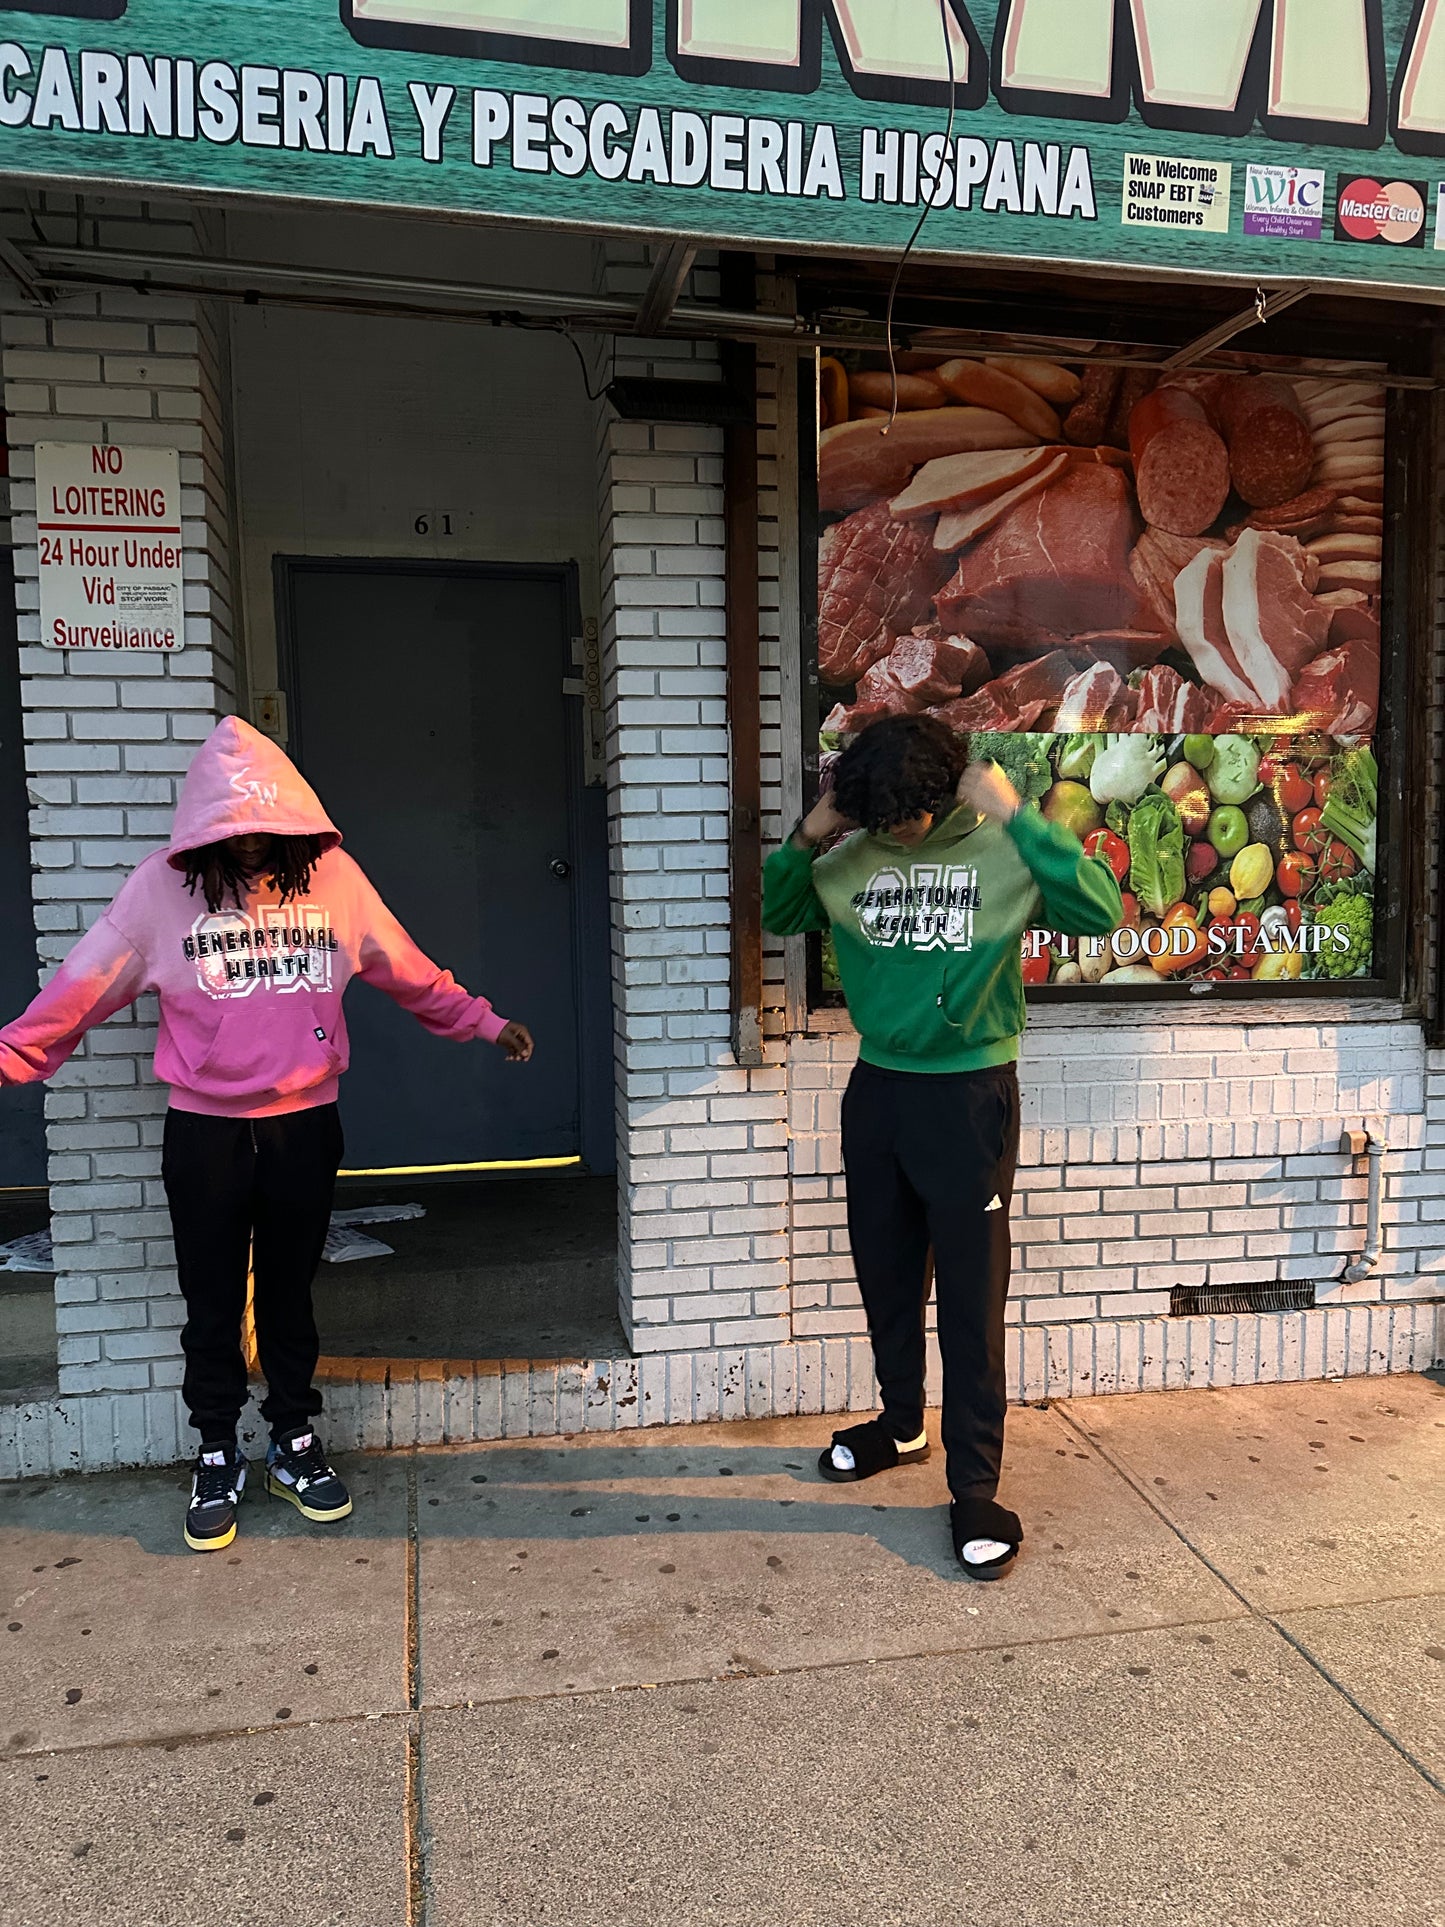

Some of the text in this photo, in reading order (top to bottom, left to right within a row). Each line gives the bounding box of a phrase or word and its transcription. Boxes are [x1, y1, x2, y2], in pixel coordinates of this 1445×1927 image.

[0, 42, 1097, 219] CARNISERIA Y PESCADERIA HISPANA
[1130, 158, 1218, 182] We Welcome
[1128, 180, 1165, 199] SNAP
[1170, 184, 1195, 202] EBT
[1127, 203, 1204, 225] Customers
[1252, 215, 1270, 225] Every
[1270, 216, 1285, 224] Child
[1340, 199, 1422, 223] MasterCard
[92, 445, 123, 475] NO
[52, 486, 166, 518] LOITERING
[40, 537, 182, 569] 24 Hour Under
[850, 886, 983, 911] GENERATIONAL
[876, 913, 949, 935] WEALTH
[182, 926, 339, 962] GENERATIONAL
[1086, 926, 1197, 957] FOOD
[1207, 924, 1351, 956] STAMPS
[223, 953, 311, 981] WEALTH
